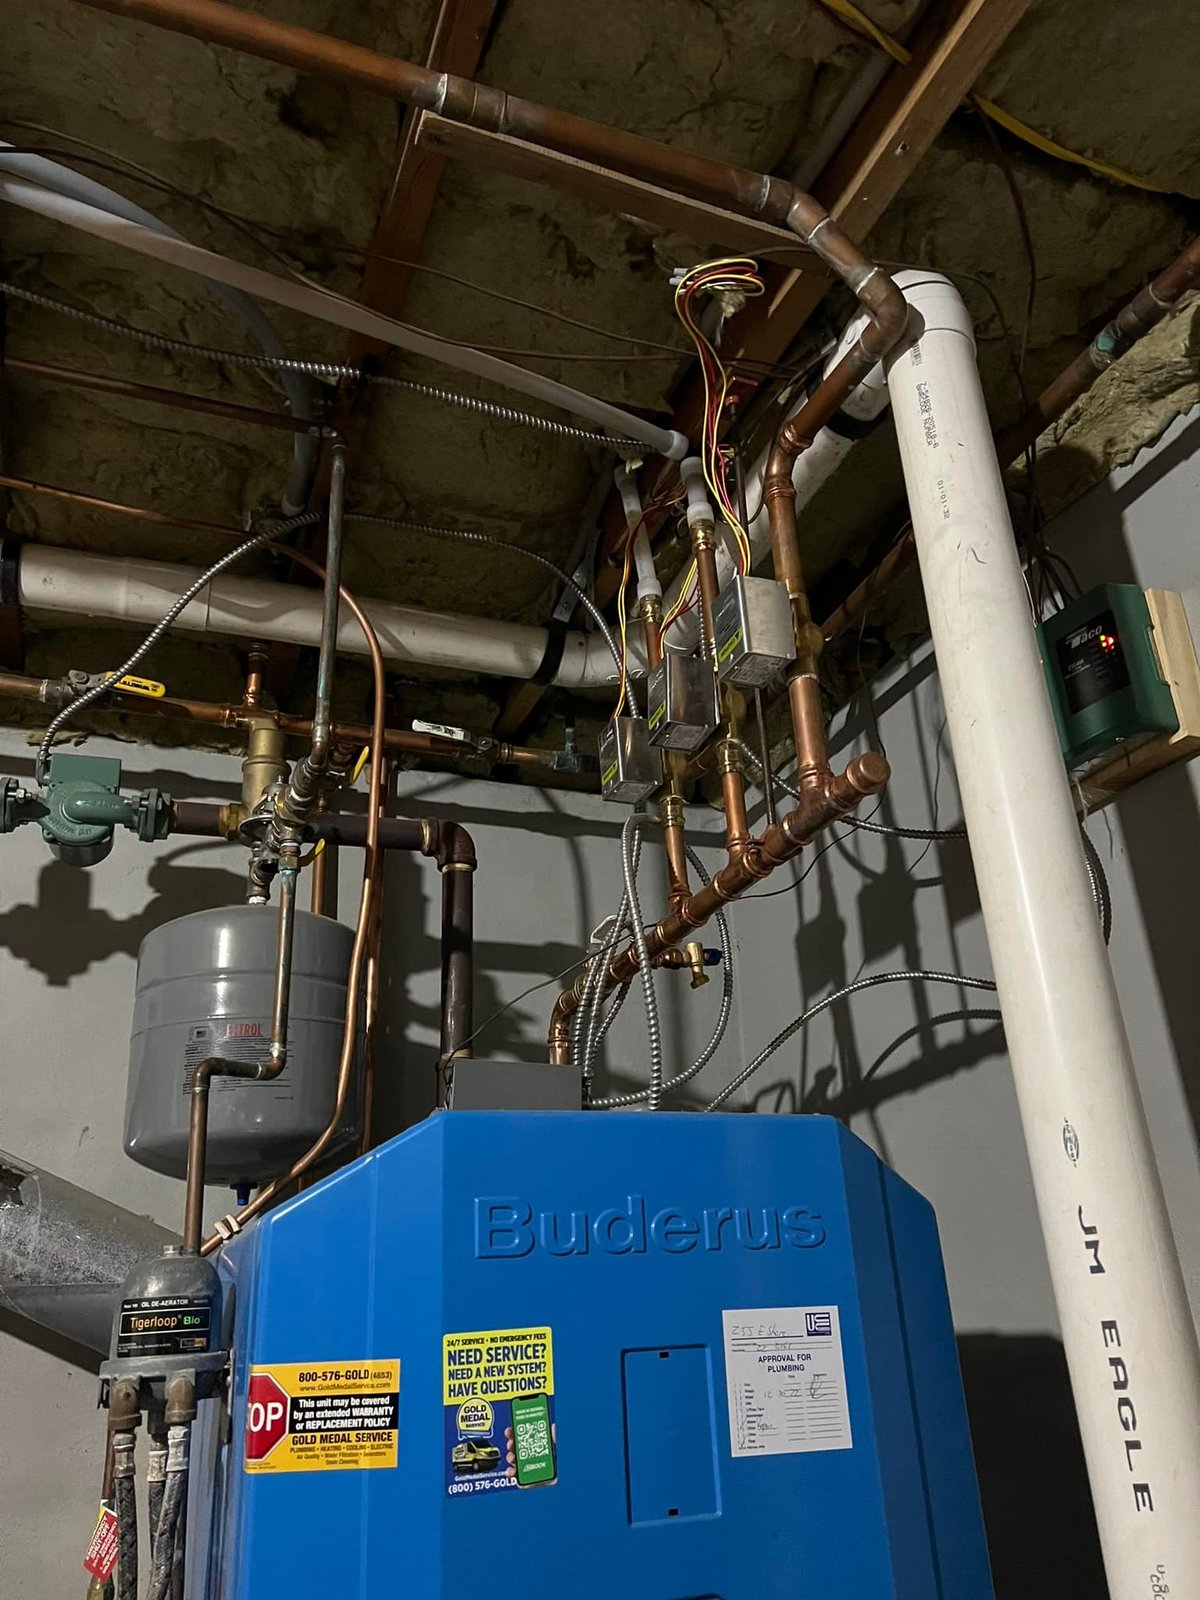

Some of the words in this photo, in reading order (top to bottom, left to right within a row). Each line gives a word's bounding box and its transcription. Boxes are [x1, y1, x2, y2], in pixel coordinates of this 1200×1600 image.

[474, 1194, 826, 1260] Buderus
[152, 1299, 188, 1307] DE-AERATOR
[446, 1339, 460, 1348] 24/7
[500, 1334, 532, 1342] EMERGENCY
[448, 1348, 482, 1366] NEED
[486, 1343, 546, 1363] SERVICE?
[758, 1354, 795, 1364] APPROVAL
[797, 1353, 812, 1361] FOR
[1078, 1205, 1106, 1274] JM
[1101, 1320, 1154, 1512] EAGLE
[448, 1368, 473, 1381] NEED
[475, 1367, 482, 1379] A
[484, 1365, 506, 1378] NEW
[508, 1362, 546, 1376] SYSTEM?
[768, 1364, 805, 1373] PLUMBING
[298, 1369, 370, 1382] 800-576-GOLD
[448, 1382, 478, 1398] HAVE
[480, 1376, 547, 1394] QUESTIONS?
[299, 1399, 314, 1408] This
[316, 1398, 332, 1408] unit
[332, 1398, 350, 1408] may
[350, 1396, 360, 1406] be
[362, 1396, 390, 1406] covered
[294, 1410, 303, 1420] by
[304, 1410, 314, 1419] an
[316, 1408, 350, 1418] extended
[352, 1406, 394, 1416] WARRANTY
[464, 1405, 486, 1414] GOLD
[296, 1422, 304, 1430] or
[306, 1419, 363, 1430] REPLACEMENT
[364, 1417, 391, 1428] POLICY
[460, 1413, 490, 1422] MEDAL
[292, 1434, 316, 1445] GOLD
[320, 1433, 352, 1444] MEDAL
[355, 1432, 392, 1443] SERVICE
[448, 1483, 473, 1495] (800)
[475, 1477, 518, 1490] 576-GOLD
